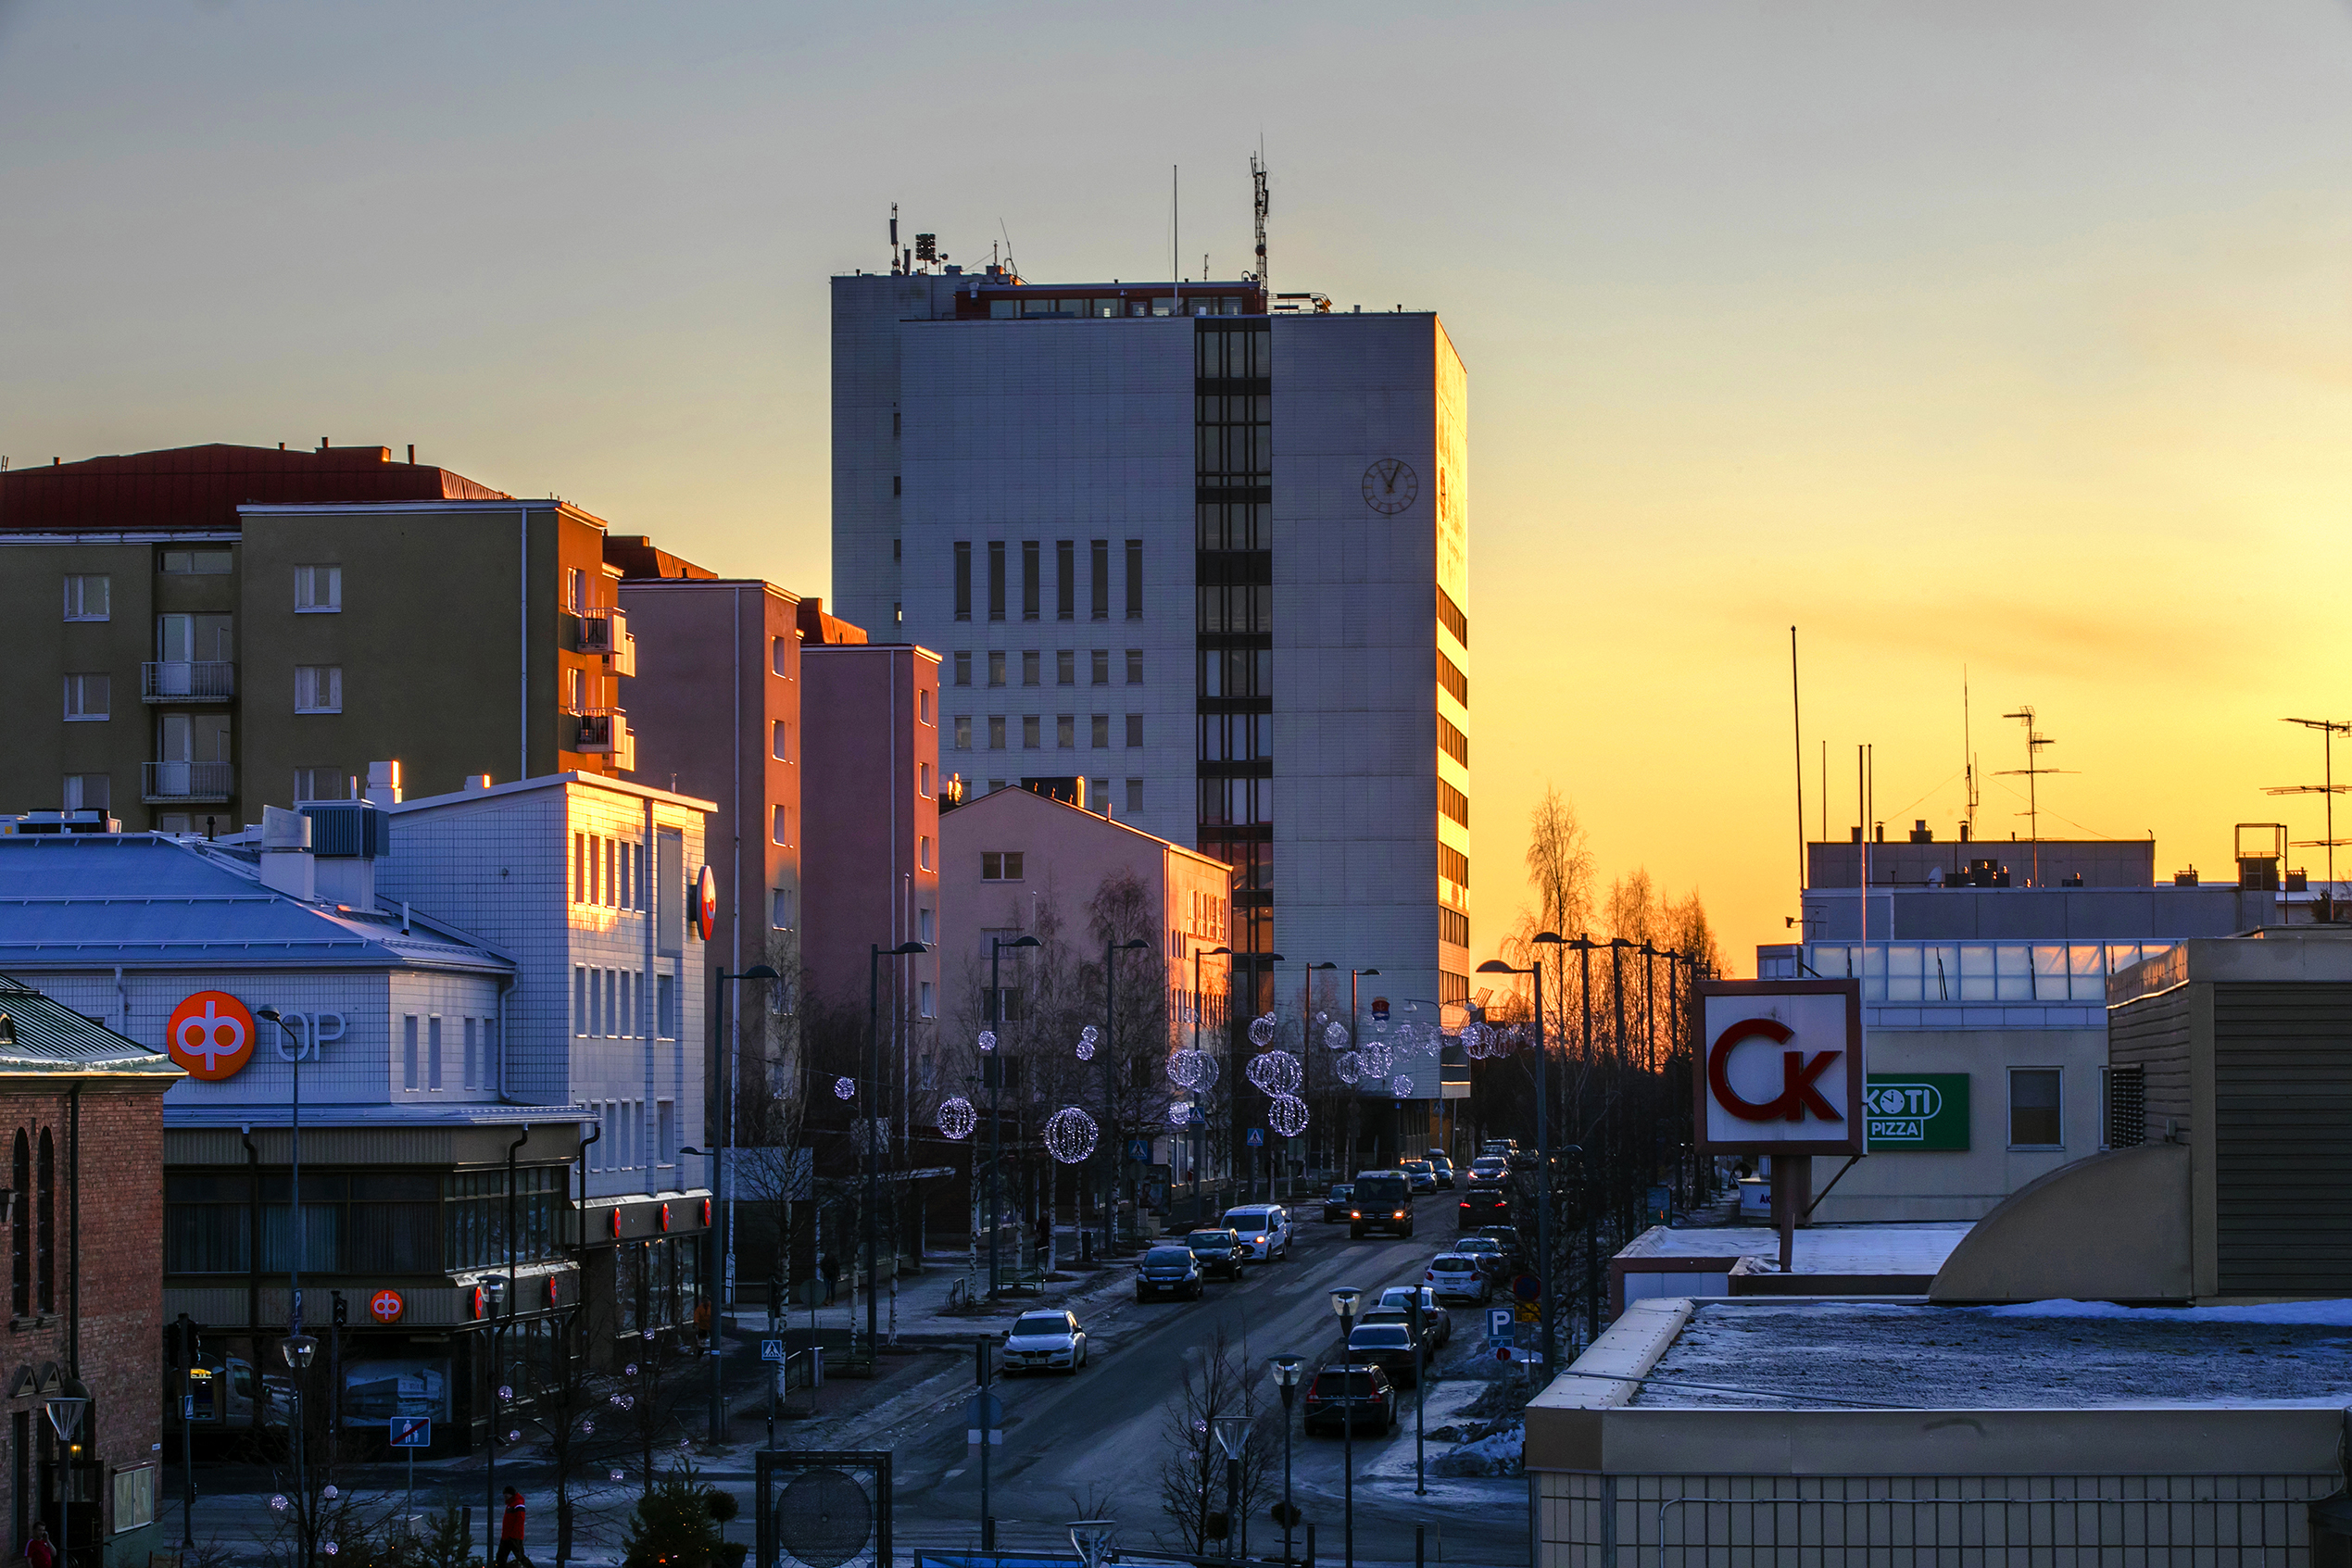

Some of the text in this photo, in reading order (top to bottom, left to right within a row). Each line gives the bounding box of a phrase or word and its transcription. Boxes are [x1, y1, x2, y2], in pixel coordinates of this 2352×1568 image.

[276, 1010, 346, 1061] OP
[1871, 1122, 1918, 1135] PIZZA
[1492, 1311, 1510, 1336] P
